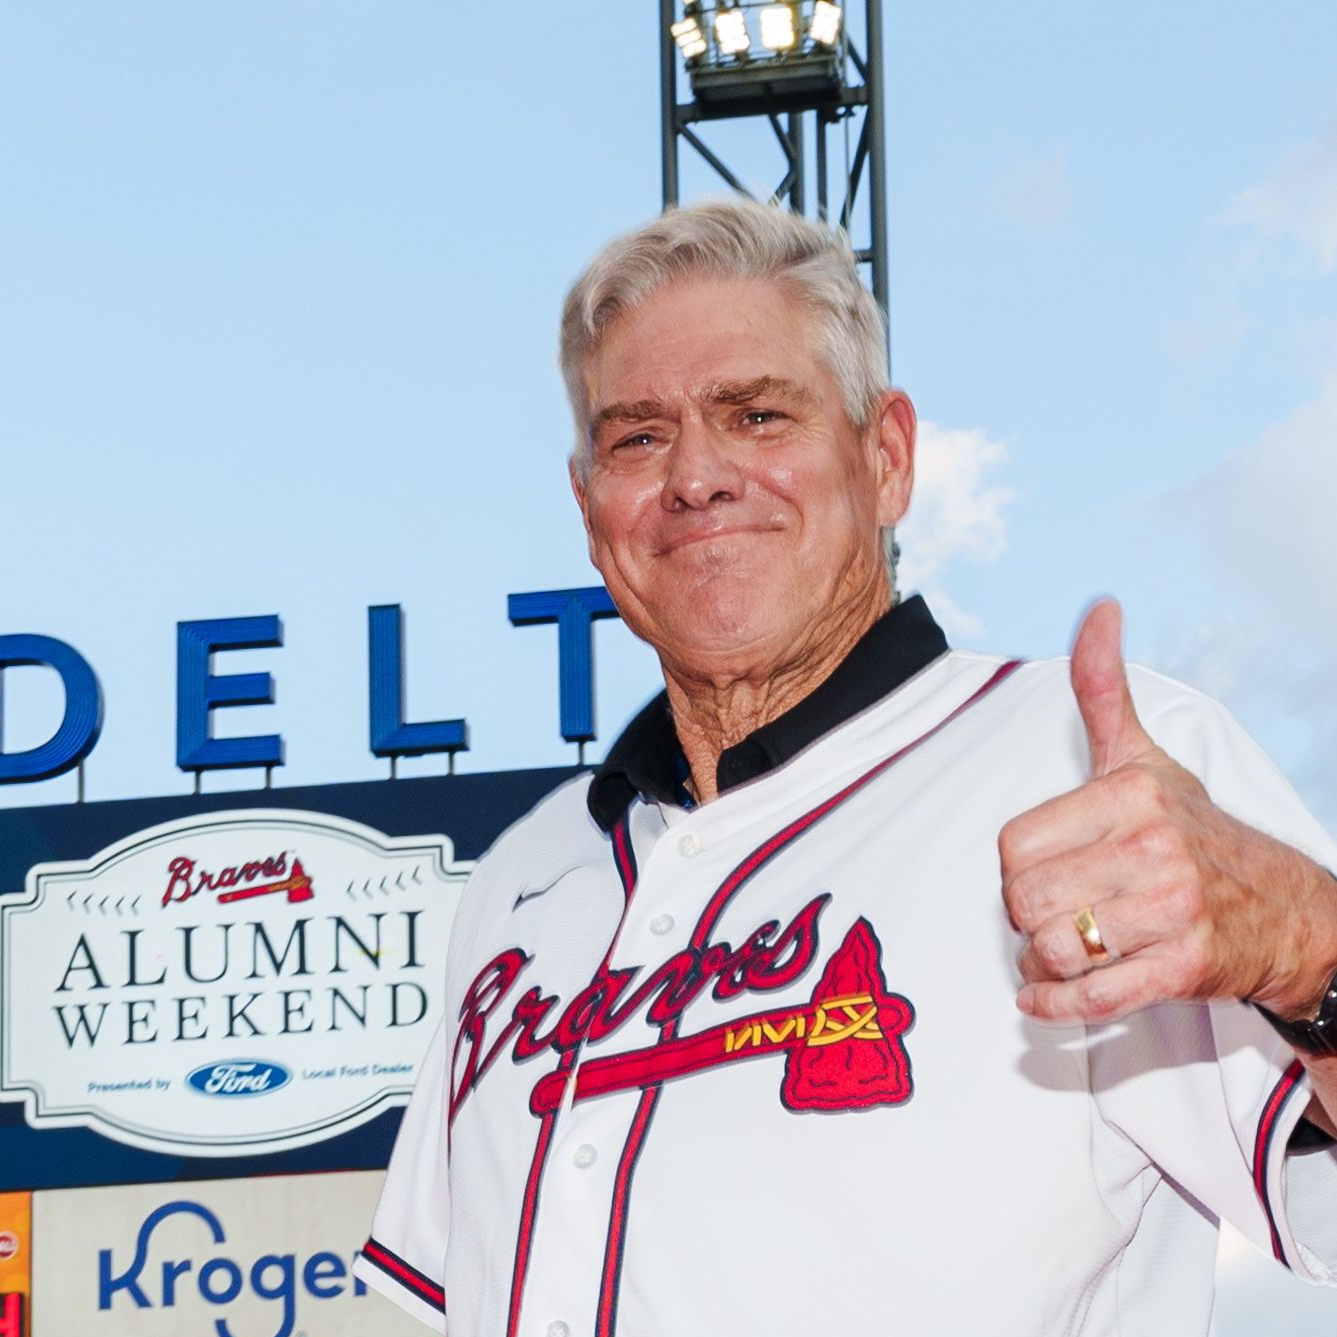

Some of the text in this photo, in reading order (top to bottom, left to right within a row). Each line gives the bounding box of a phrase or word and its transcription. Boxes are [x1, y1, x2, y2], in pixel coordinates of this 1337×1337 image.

[162, 851, 287, 908] Braves
[53, 909, 426, 994] ALUMNI
[50, 982, 429, 1048] WEEKEND
[449, 892, 833, 1122] Braves
[87, 1078, 152, 1093] Presented
[156, 1078, 170, 1092] by
[204, 1062, 270, 1094] Ford
[302, 1068, 335, 1080] Local
[340, 1065, 367, 1078] Ford
